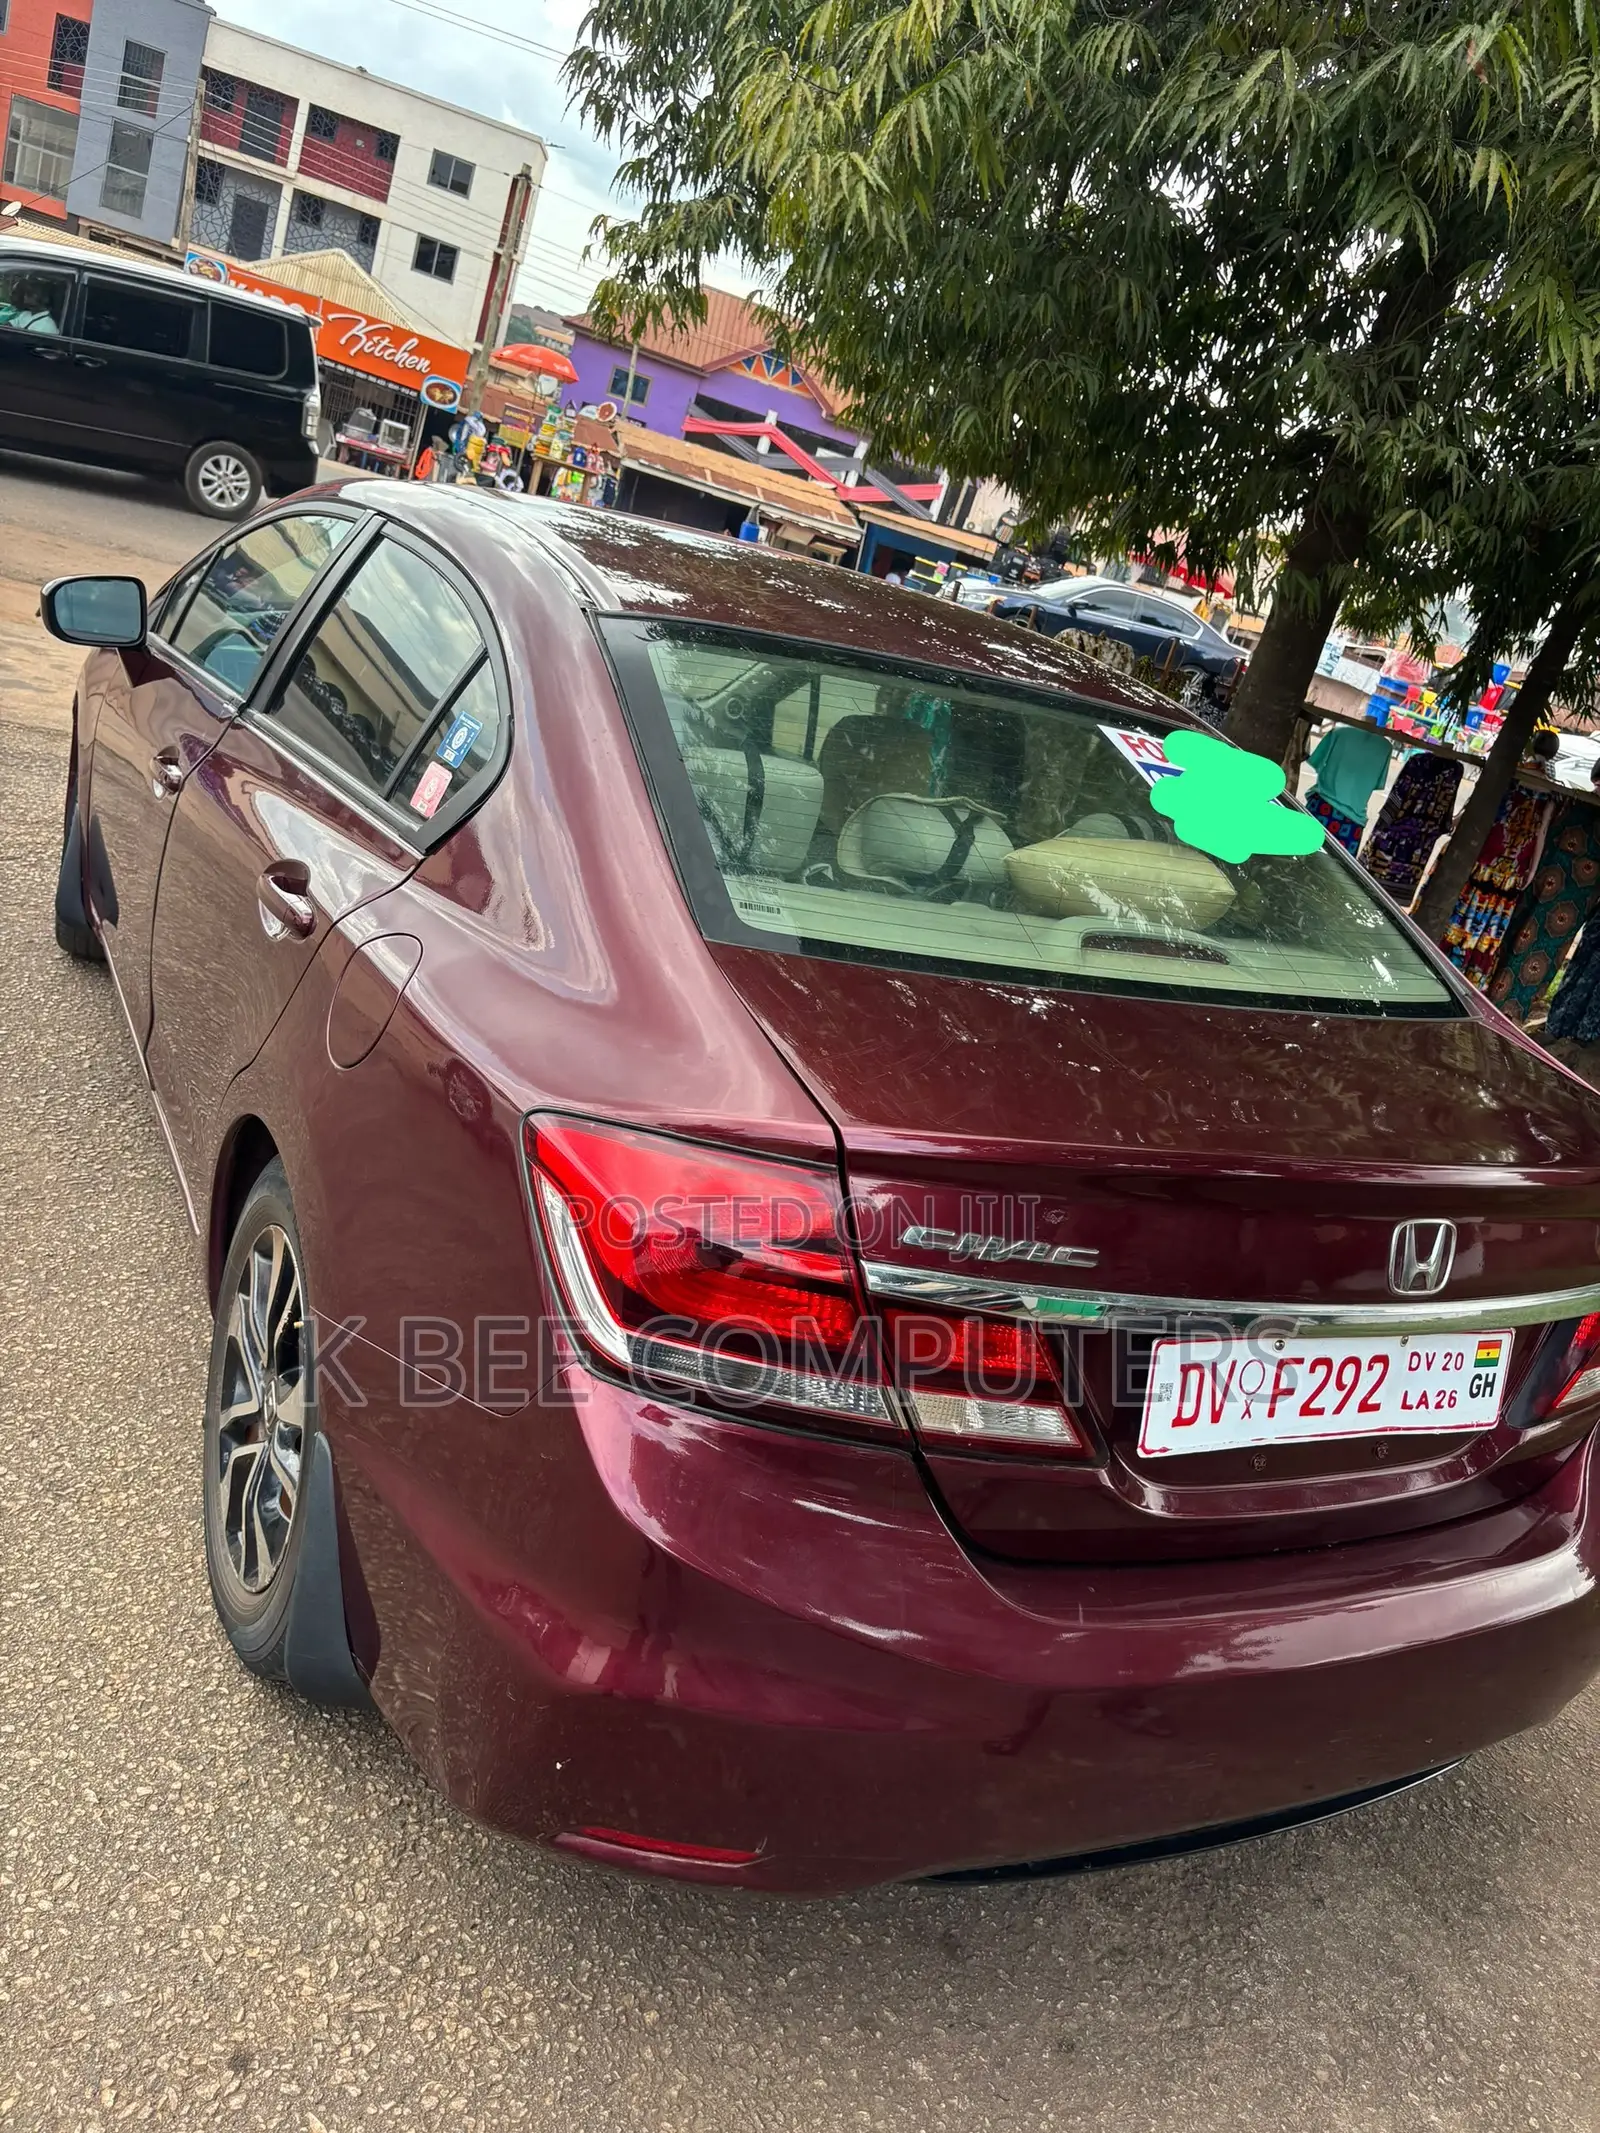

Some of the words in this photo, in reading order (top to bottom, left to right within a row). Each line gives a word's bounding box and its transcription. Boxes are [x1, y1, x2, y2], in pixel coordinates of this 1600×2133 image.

[327, 313, 431, 374] Kitchen
[1117, 732, 1169, 764] FO
[898, 1225, 1100, 1268] CIVIC
[1407, 1351, 1436, 1372] DV
[1440, 1350, 1465, 1372] 20
[1171, 1359, 1237, 1428] DV
[1267, 1353, 1390, 1419] F292
[1400, 1391, 1430, 1411] LA
[1433, 1389, 1458, 1409] 26
[1468, 1371, 1497, 1399] GH
